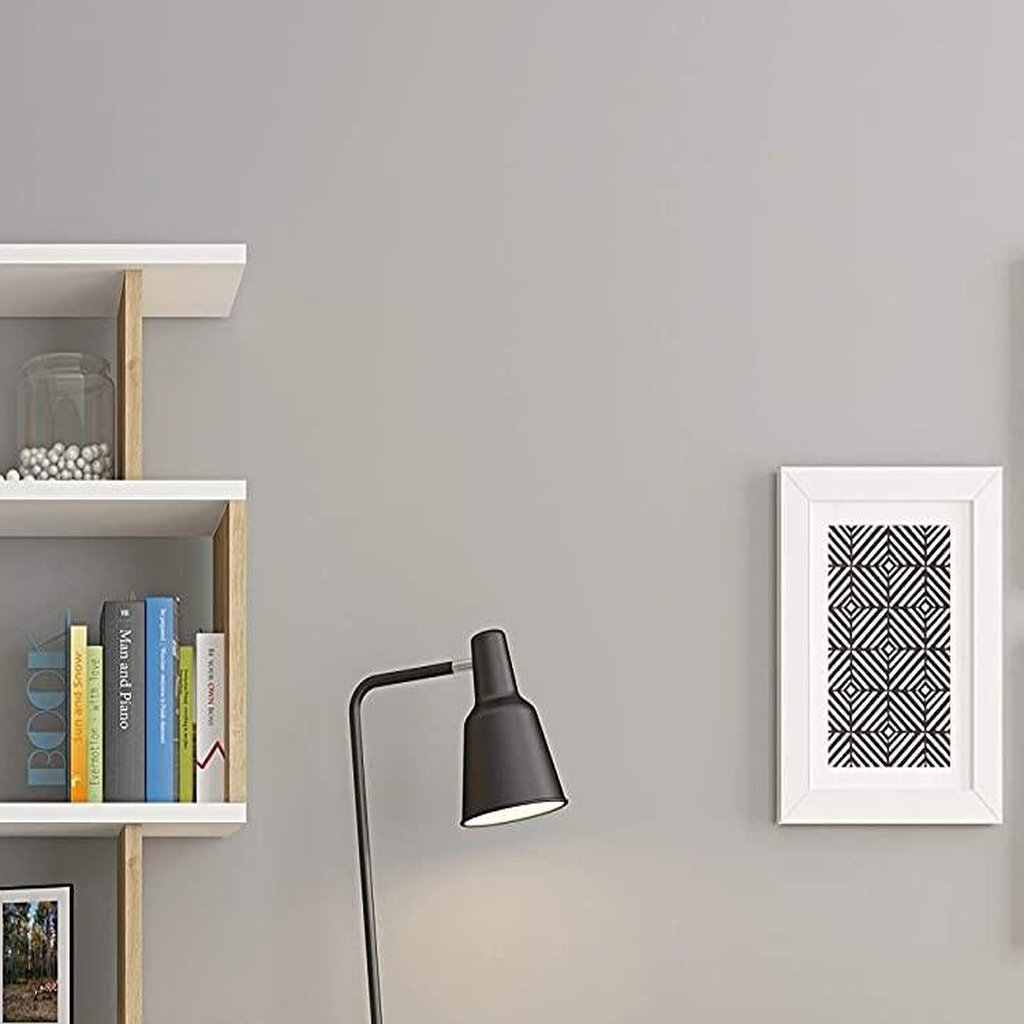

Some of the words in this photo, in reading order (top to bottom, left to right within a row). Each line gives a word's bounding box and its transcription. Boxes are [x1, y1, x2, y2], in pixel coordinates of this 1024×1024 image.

[119, 629, 132, 659] Man
[75, 653, 83, 688] Snow
[119, 662, 132, 687] and
[207, 681, 215, 706] OWN
[119, 692, 132, 730] Piano
